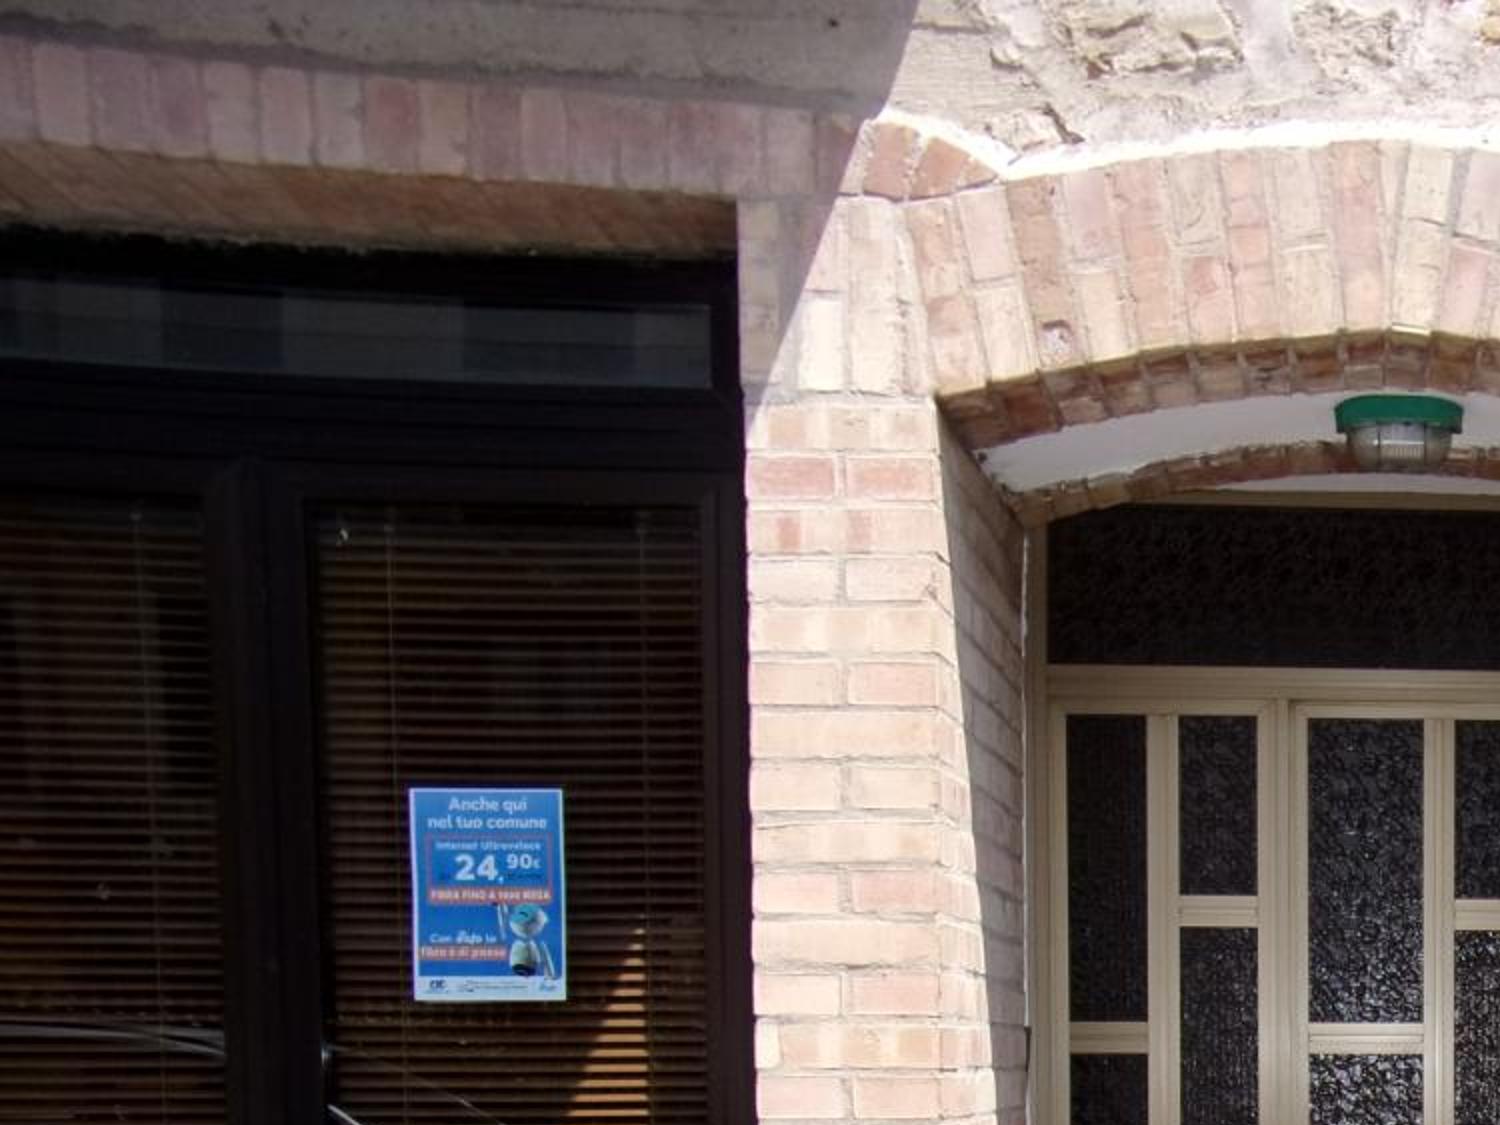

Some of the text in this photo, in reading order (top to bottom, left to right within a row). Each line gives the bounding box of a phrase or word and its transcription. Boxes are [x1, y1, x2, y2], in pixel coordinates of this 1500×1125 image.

[448, 796, 528, 815] Anche qui
[427, 814, 547, 829] nel tuo comune
